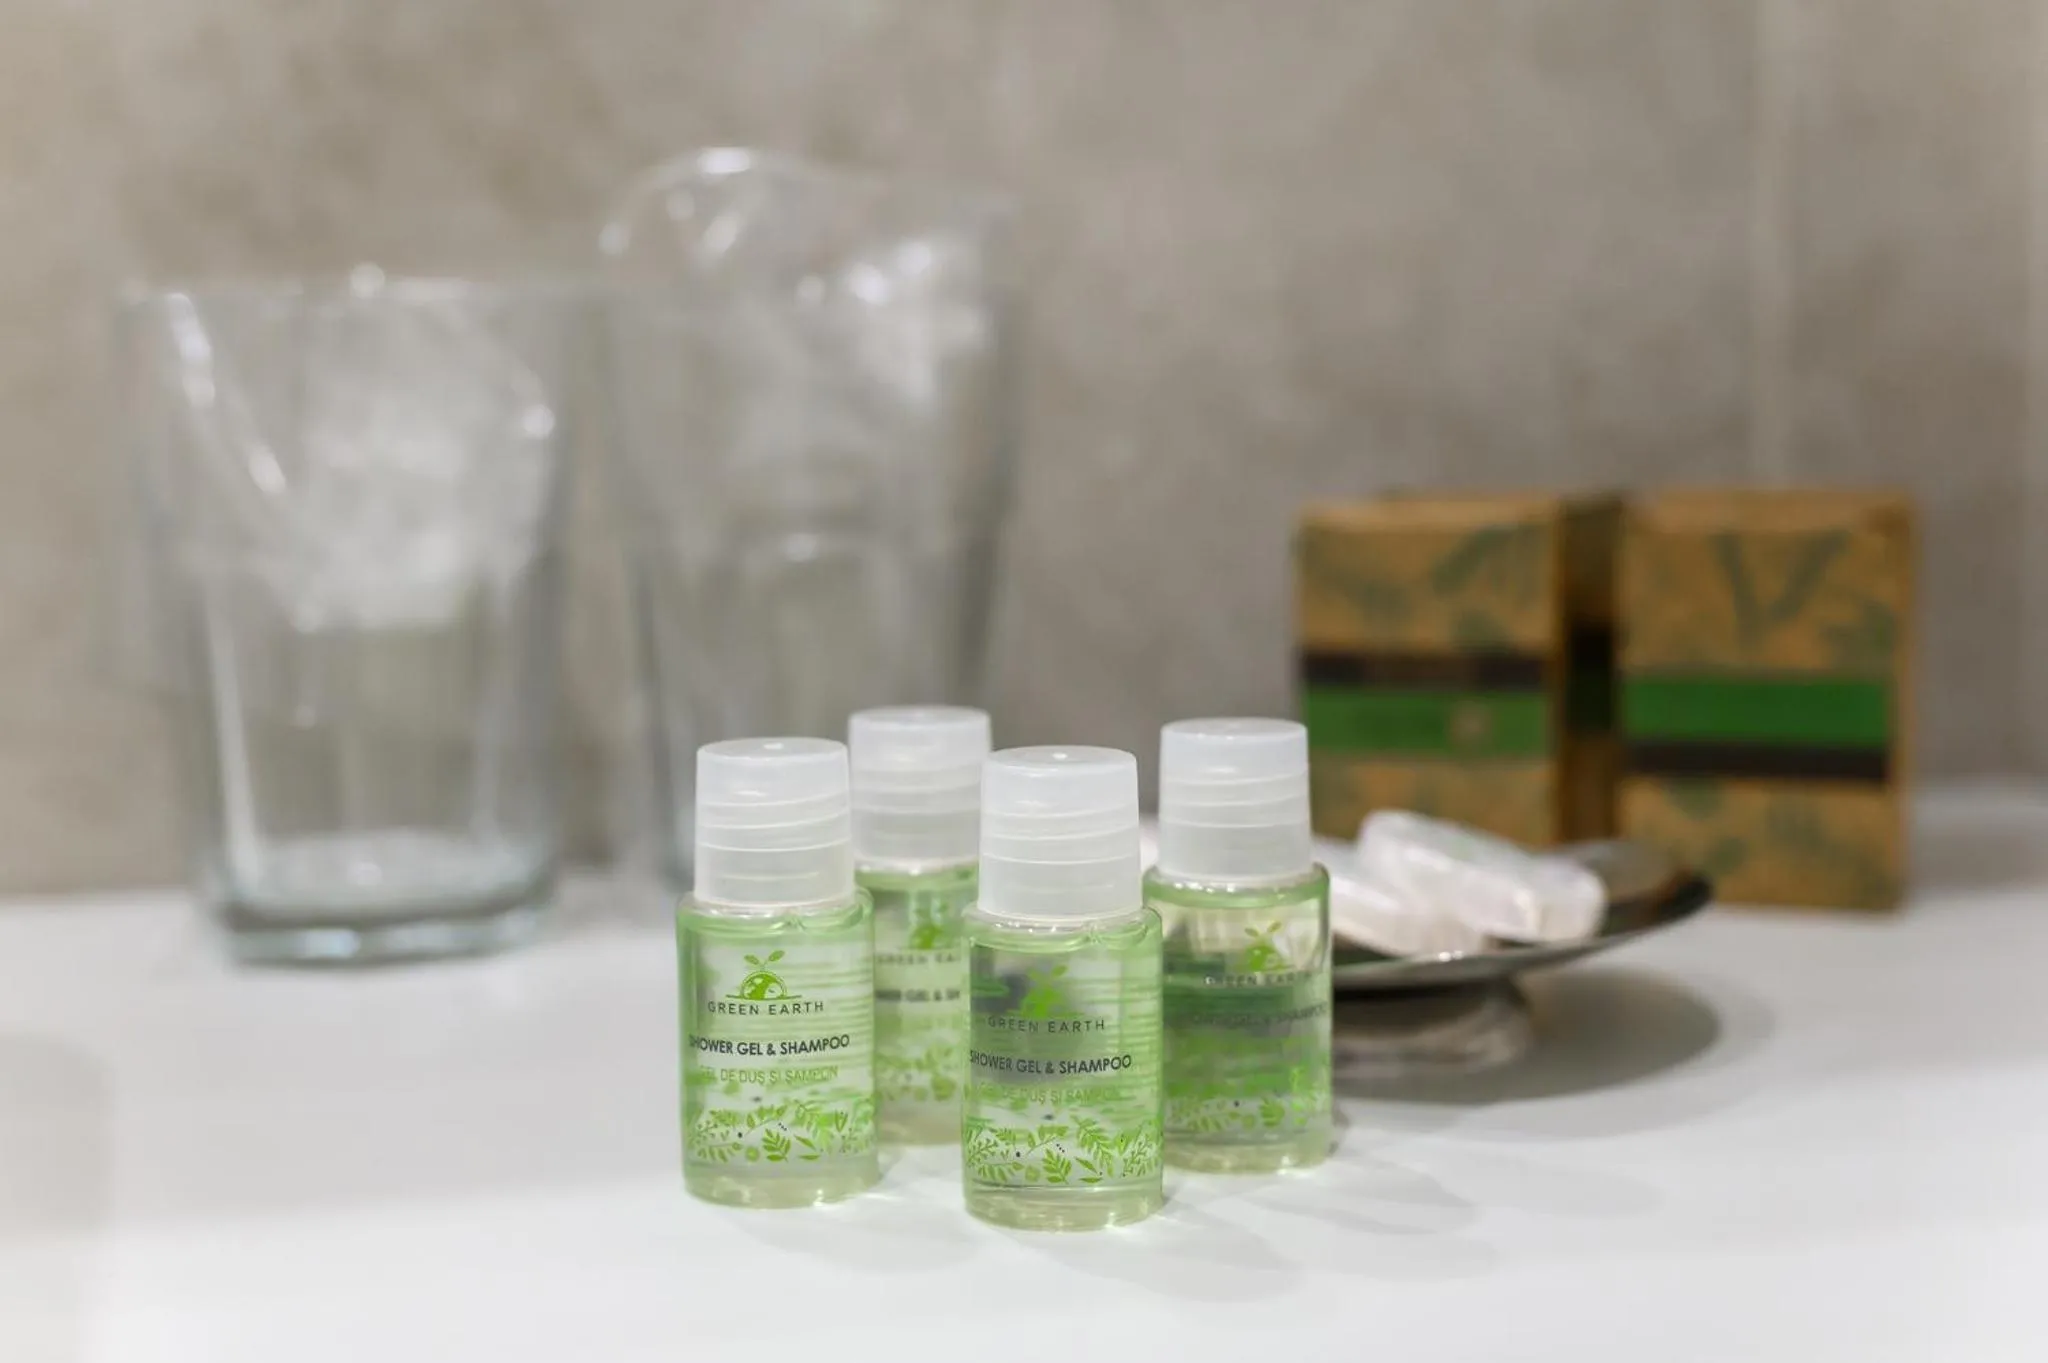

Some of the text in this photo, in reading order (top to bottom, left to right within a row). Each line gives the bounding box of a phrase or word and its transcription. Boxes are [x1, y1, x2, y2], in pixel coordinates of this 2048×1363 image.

[707, 1000, 825, 1016] GREEN EARTH
[987, 1015, 1106, 1034] GREEN EARTH
[688, 1033, 851, 1057] SHOWER GEL & SHAMPOO
[969, 1049, 1133, 1075] SHOWER GEL & SHAMPOO
